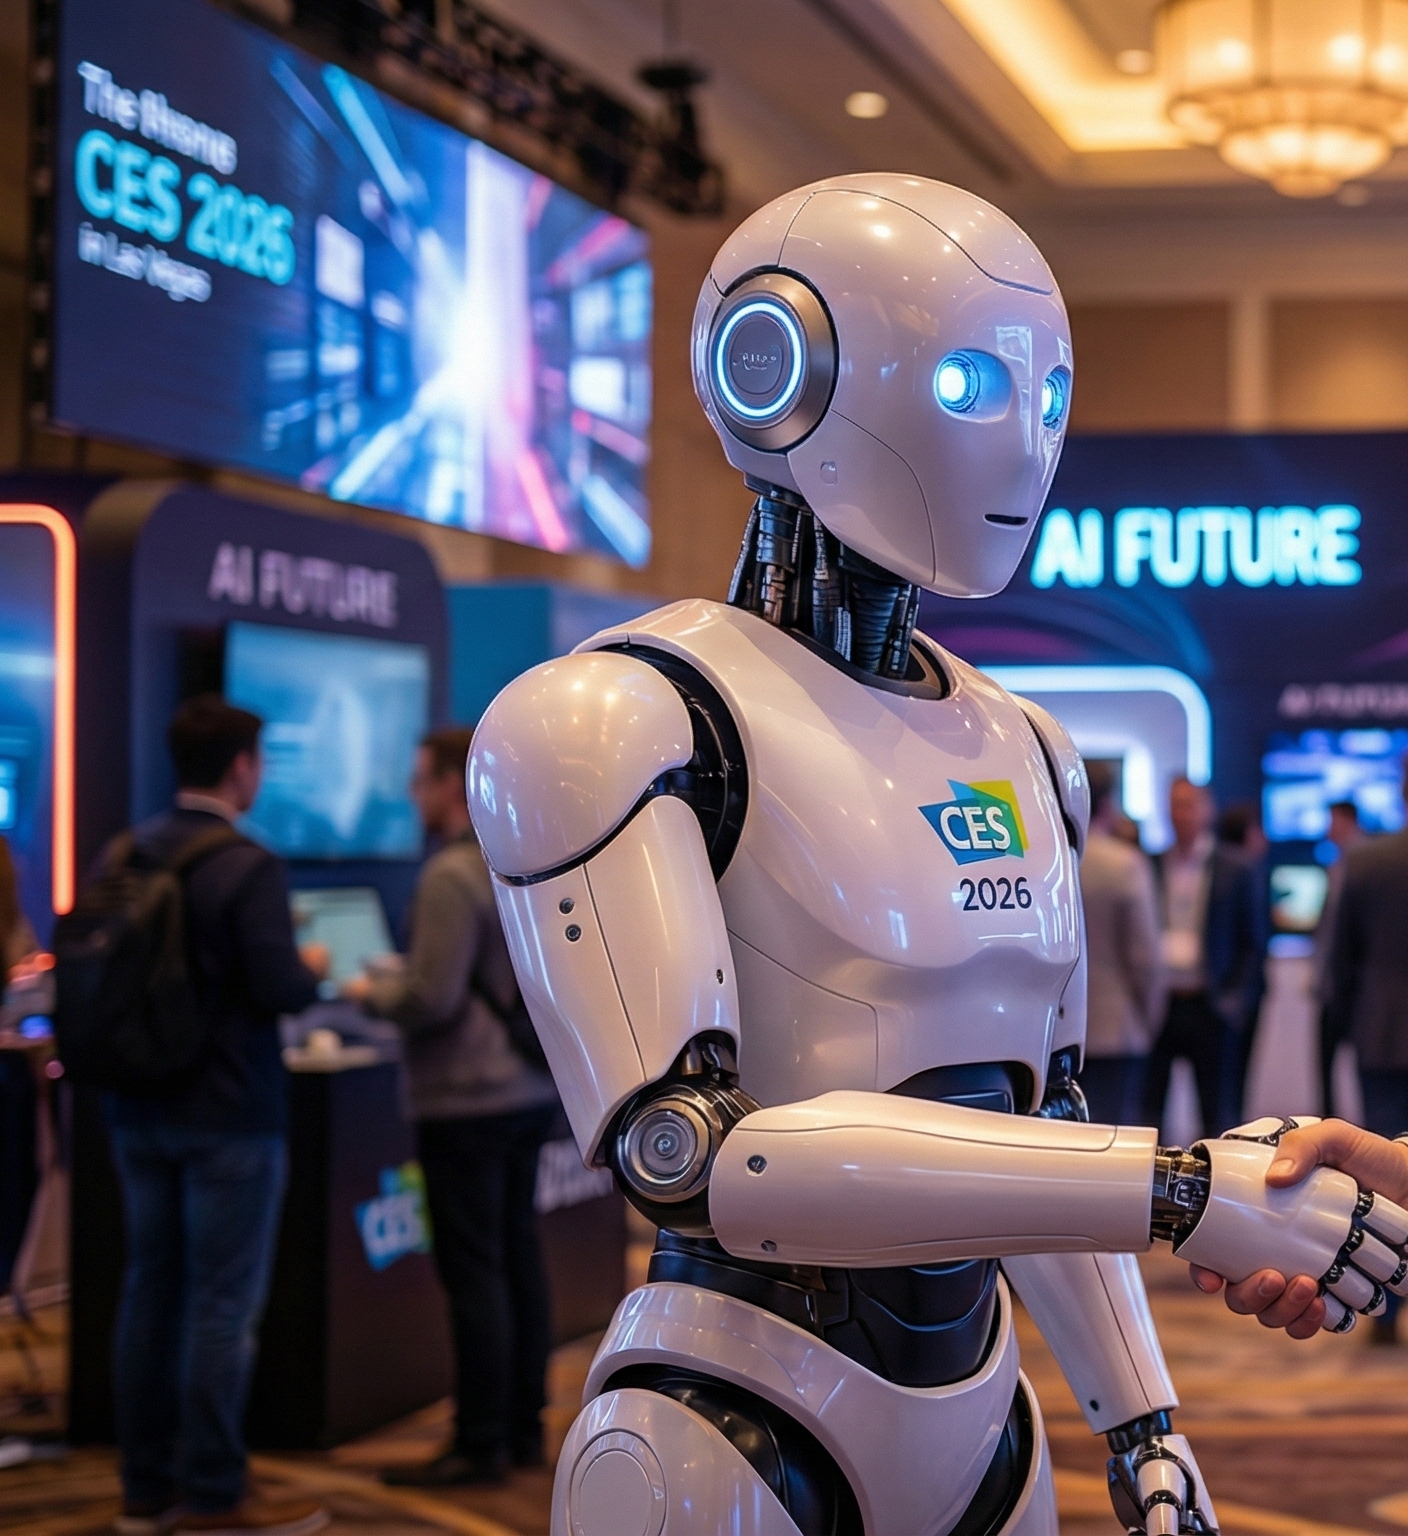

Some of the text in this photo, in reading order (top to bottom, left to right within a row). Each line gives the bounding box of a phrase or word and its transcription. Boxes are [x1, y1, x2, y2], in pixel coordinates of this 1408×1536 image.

[78, 61, 138, 130] The
[76, 129, 296, 285] CES 2026
[208, 541, 398, 628] AI FUTURE
[1030, 505, 1362, 588] AI FUTURE
[940, 806, 1011, 850] CES
[960, 877, 1032, 911] 2026
